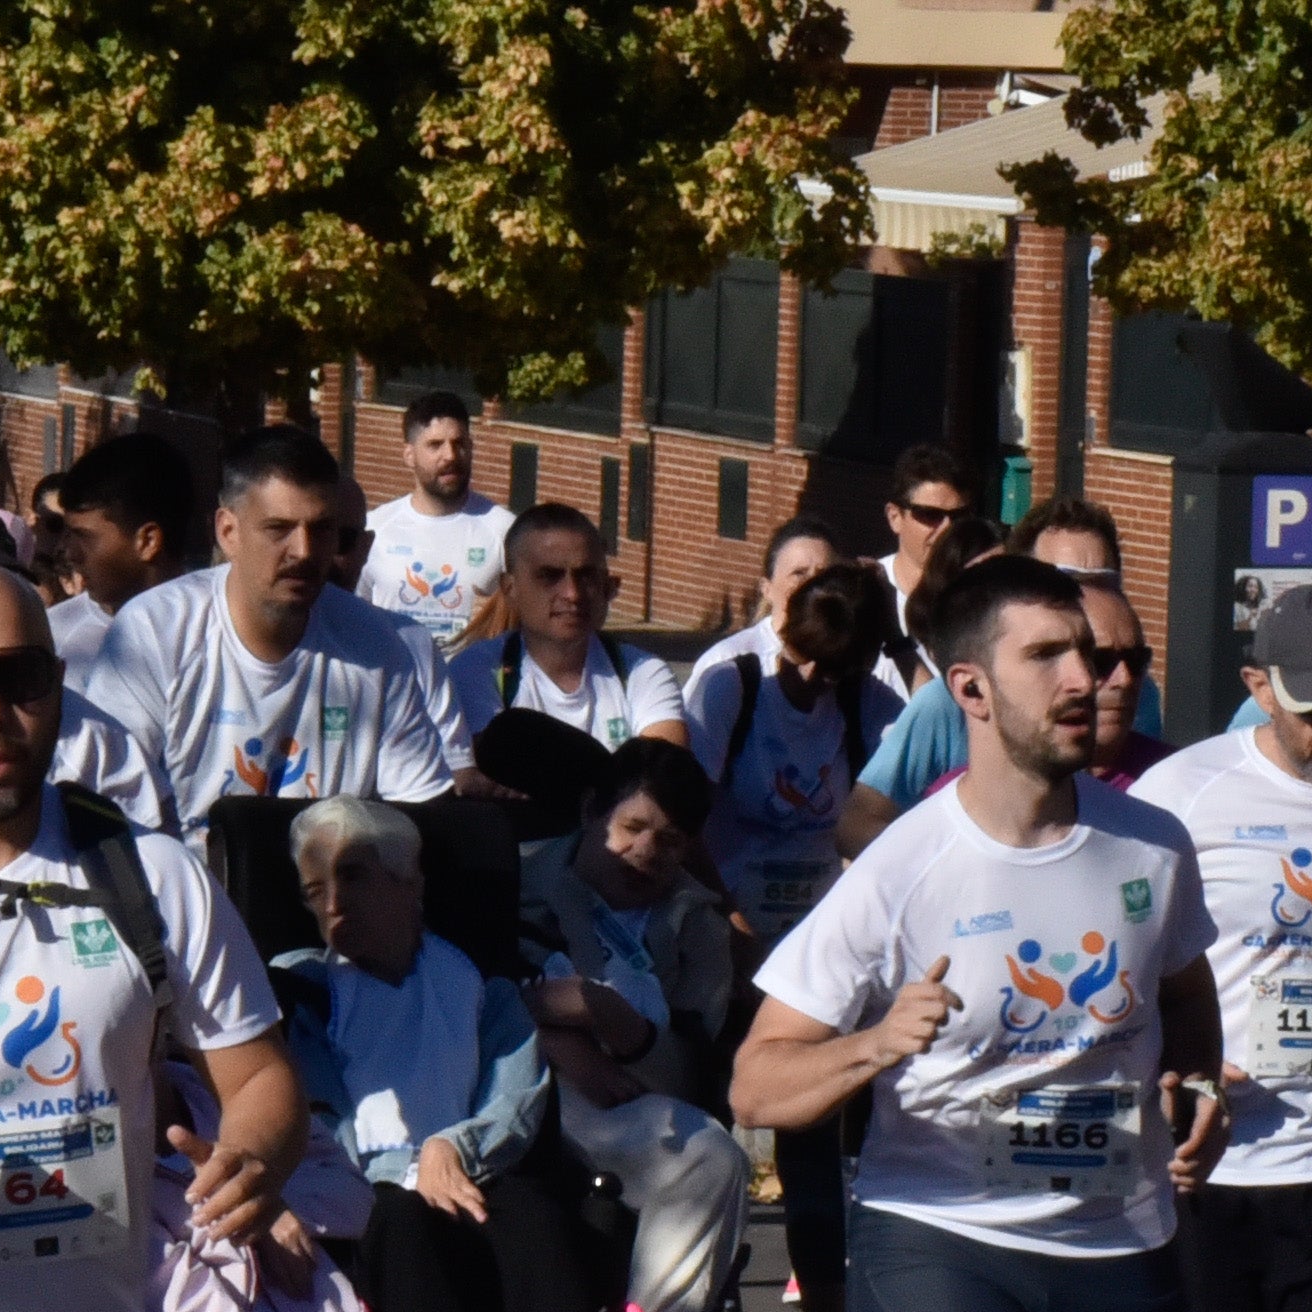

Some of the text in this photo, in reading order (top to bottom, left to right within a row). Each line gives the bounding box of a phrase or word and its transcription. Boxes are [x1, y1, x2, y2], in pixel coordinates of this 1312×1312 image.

[1266, 488, 1309, 548] P
[1008, 1120, 1108, 1149] 1166
[4, 1168, 69, 1206] 64
